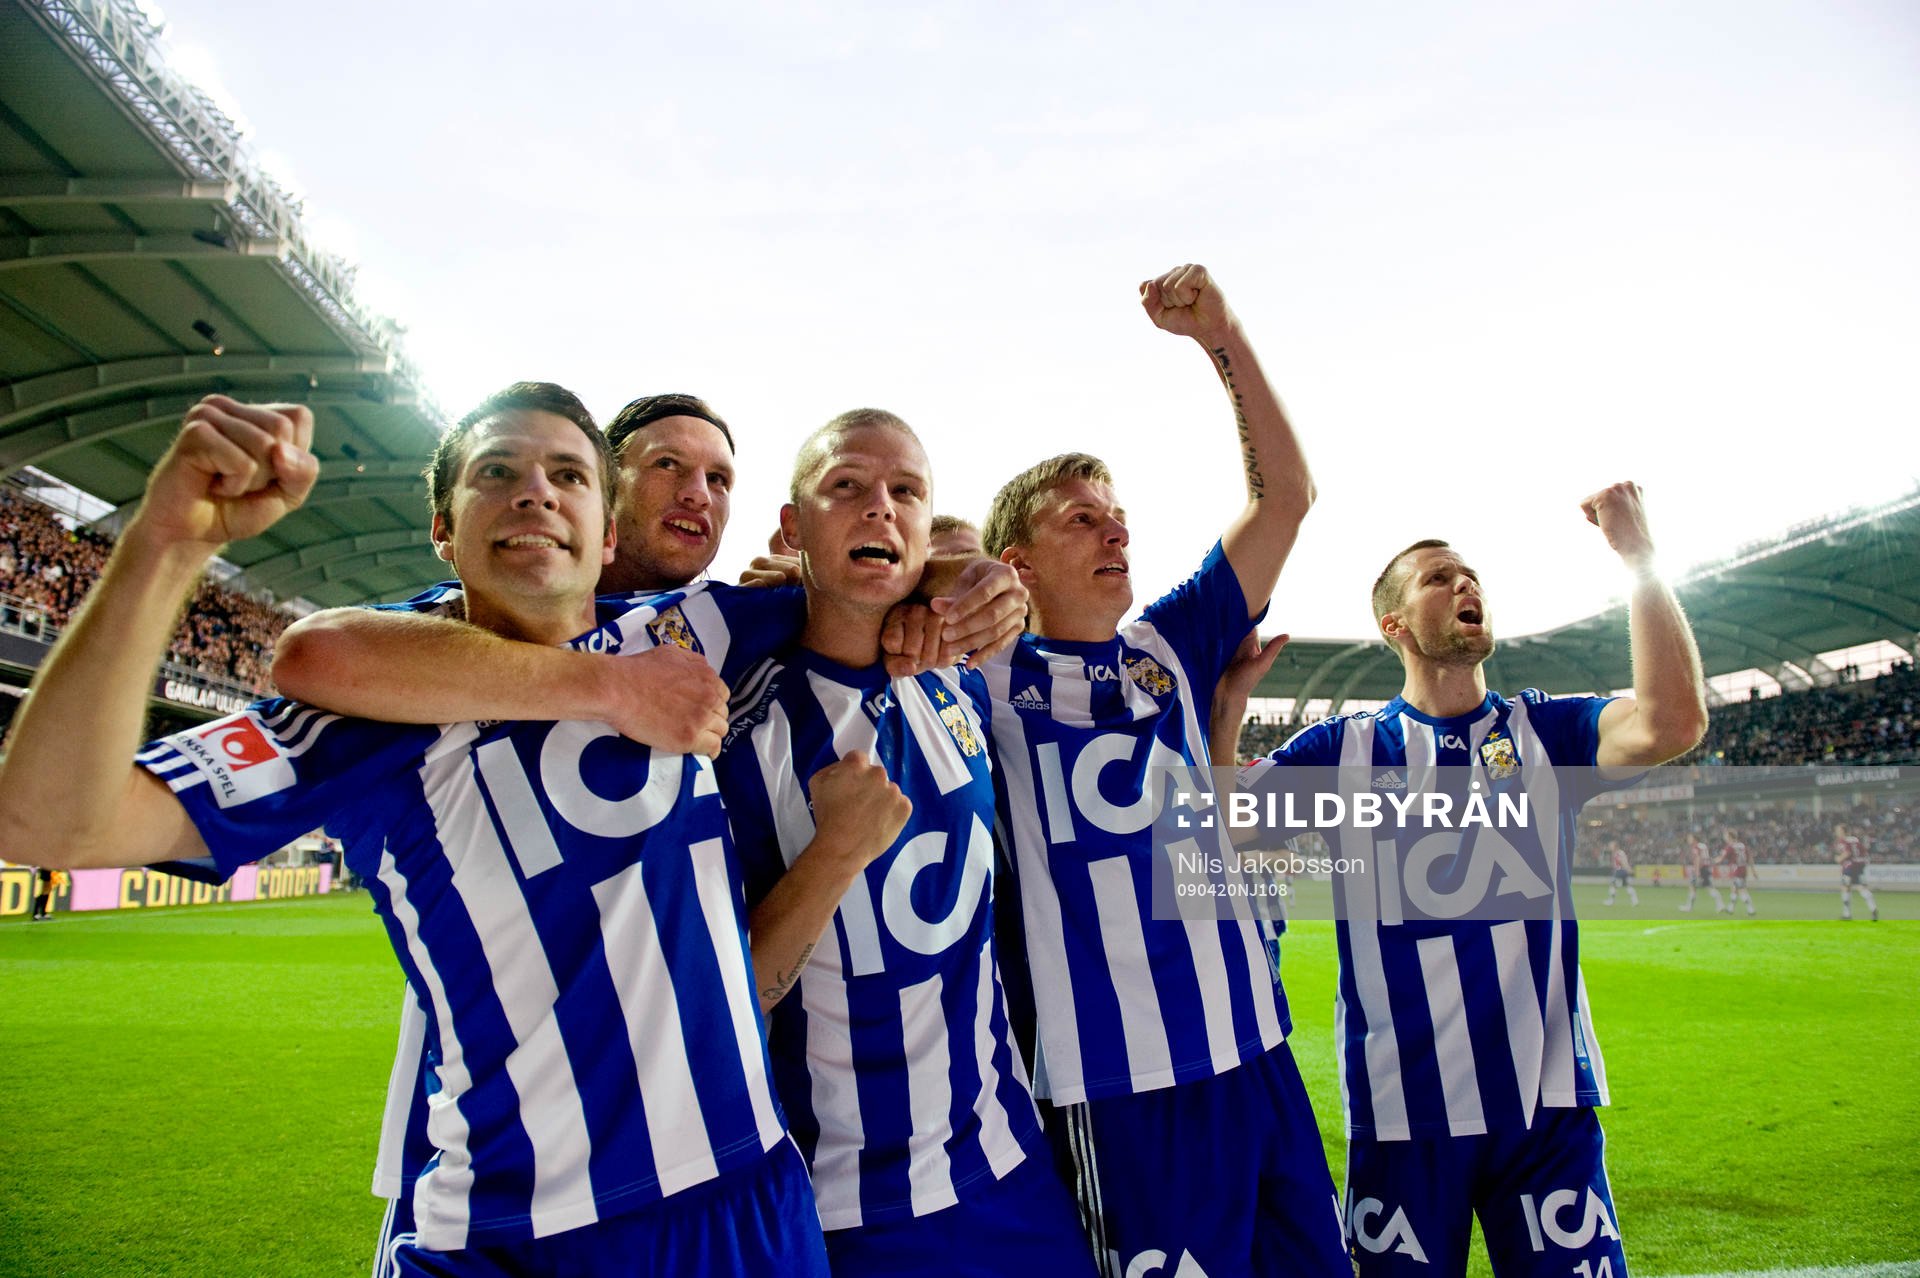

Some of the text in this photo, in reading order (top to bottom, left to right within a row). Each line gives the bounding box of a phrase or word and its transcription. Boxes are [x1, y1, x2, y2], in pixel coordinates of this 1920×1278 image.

[578, 627, 620, 654] ICA
[1088, 664, 1120, 682] ICA
[164, 680, 208, 708] GAMLA
[1009, 699, 1051, 711] adidas
[1438, 735, 1468, 751] ICA
[213, 767, 237, 799] SPEL
[1036, 732, 1218, 844] ICA
[1371, 780, 1407, 790] adidas
[1376, 822, 1554, 926] ICA
[1346, 1187, 1430, 1264] ICA
[1520, 1185, 1621, 1252] ICA
